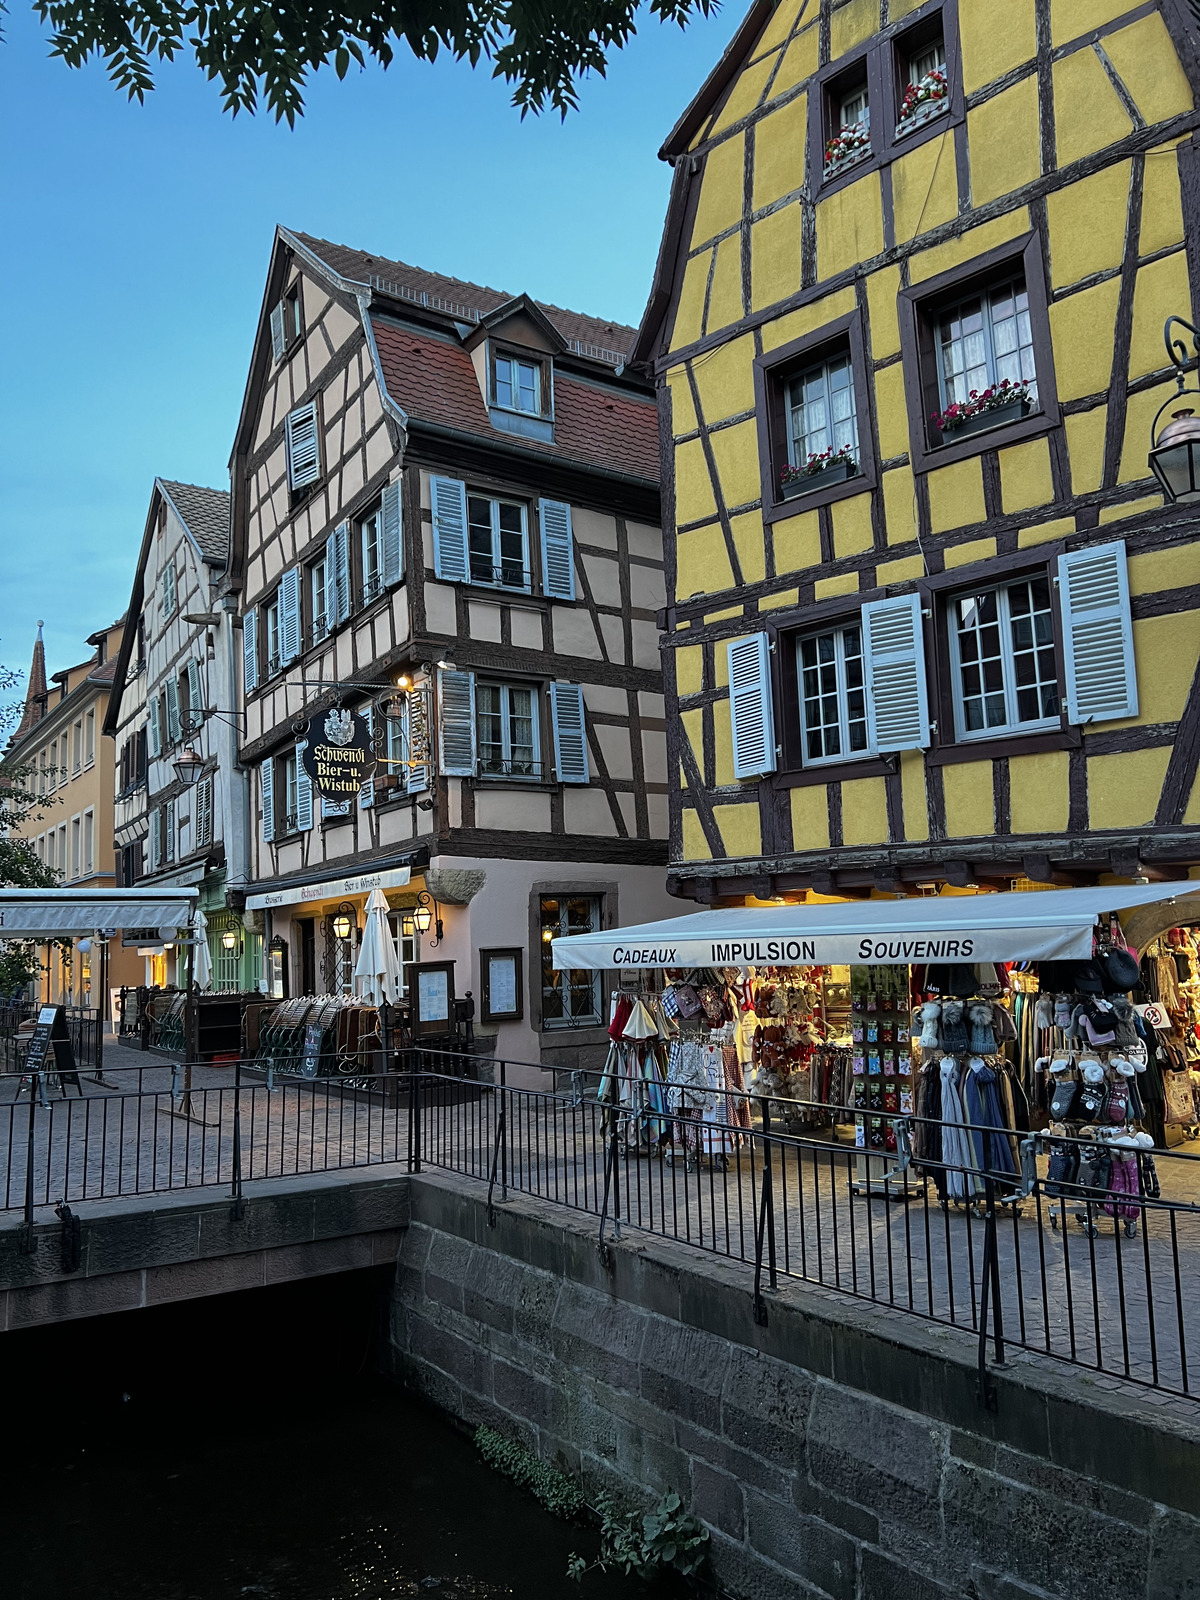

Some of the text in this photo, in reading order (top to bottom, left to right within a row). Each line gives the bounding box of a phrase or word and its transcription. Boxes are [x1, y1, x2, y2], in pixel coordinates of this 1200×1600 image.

[313, 744, 365, 763] Schwendi
[318, 777, 361, 792] Wistub
[613, 939, 974, 964] CADEAUX IMPULSION SOUVENIRS
